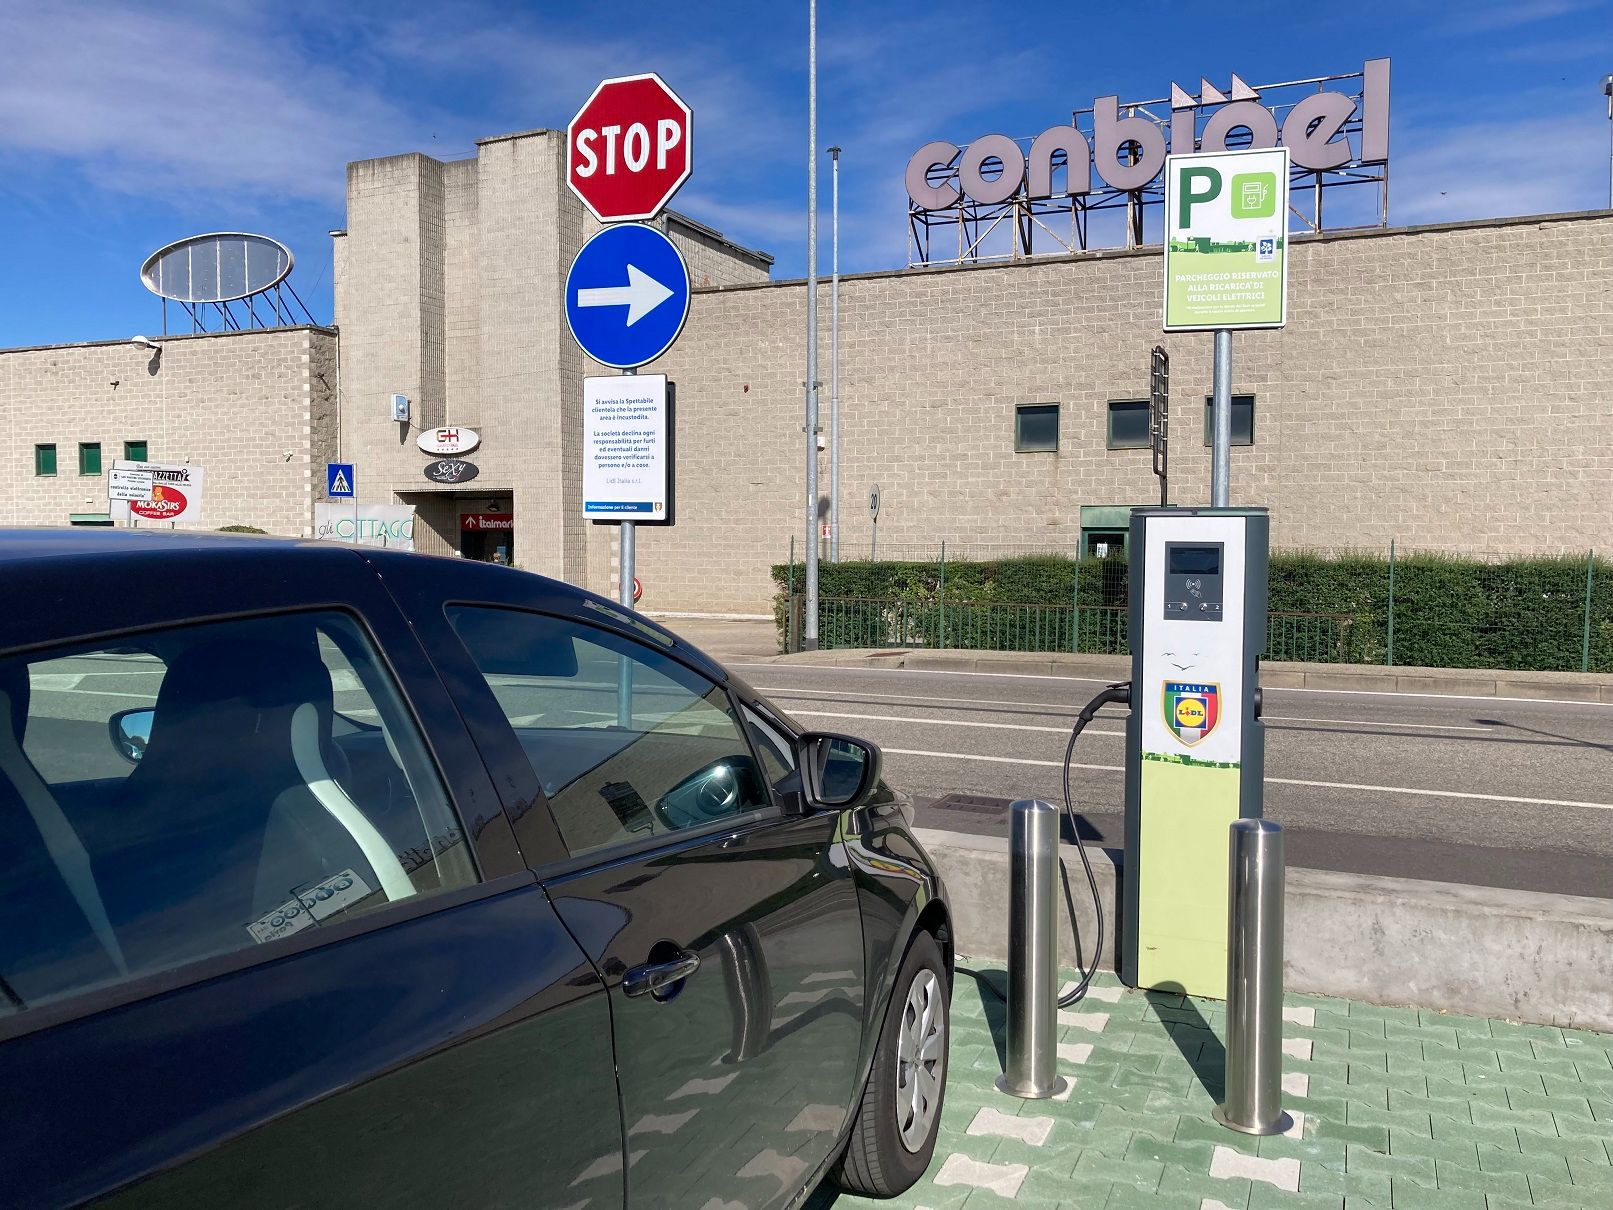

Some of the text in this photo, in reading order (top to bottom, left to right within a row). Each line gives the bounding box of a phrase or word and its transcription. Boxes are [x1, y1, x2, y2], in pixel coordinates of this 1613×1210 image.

[576, 119, 682, 178] STOP
[1178, 166, 1222, 229] P
[1176, 270, 1279, 282] PARCHEGGIO RISERVATO
[1223, 292, 1265, 300] ELETTRICI
[1174, 685, 1209, 693] ITALIA
